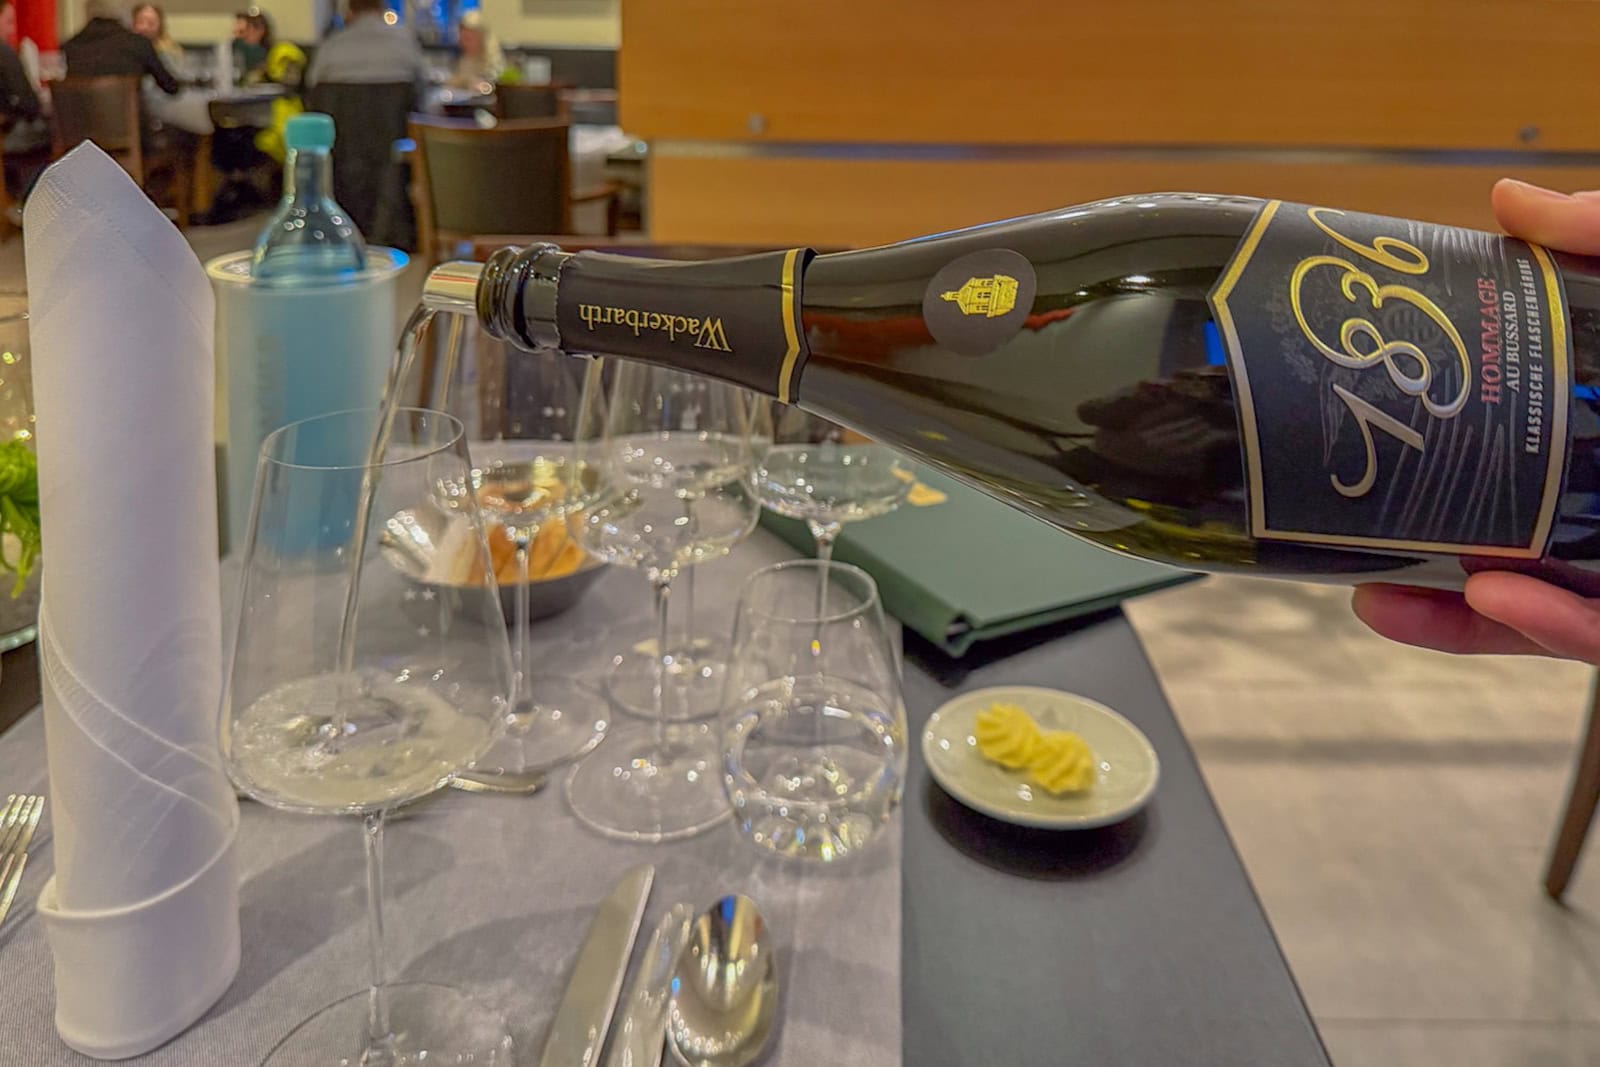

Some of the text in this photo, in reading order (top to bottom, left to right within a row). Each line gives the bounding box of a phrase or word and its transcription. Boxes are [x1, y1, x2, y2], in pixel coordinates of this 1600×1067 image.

[578, 303, 733, 353] Wackerbarth
[1290, 206, 1473, 498] 1836
[1477, 277, 1502, 405] HOMMAGE
[1502, 290, 1520, 393] AU BUSSARD
[1525, 364, 1543, 454] KLASSISCHE
